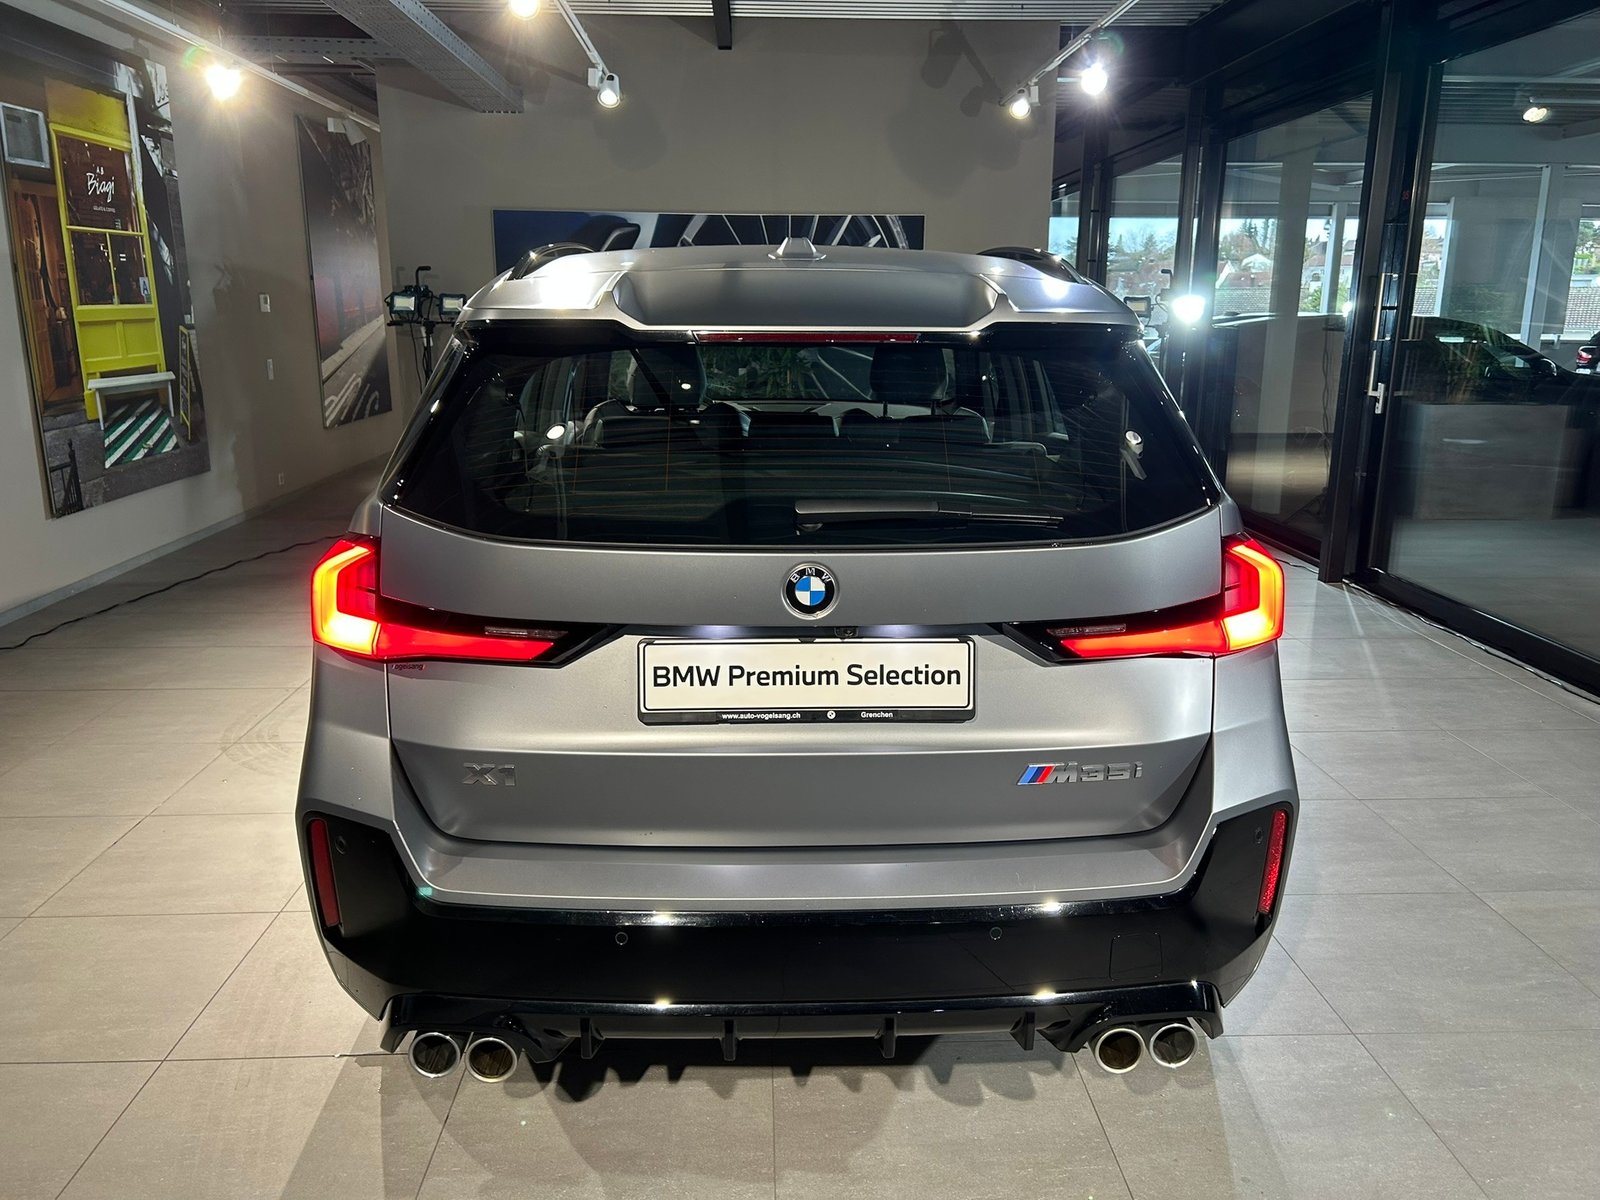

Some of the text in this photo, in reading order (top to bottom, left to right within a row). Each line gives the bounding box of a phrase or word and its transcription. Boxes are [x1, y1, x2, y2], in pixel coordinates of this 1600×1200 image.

[86, 172, 115, 203] Biagi
[790, 567, 832, 583] BMW
[652, 663, 961, 687] BMW Premium Selection
[721, 712, 801, 720] www.auto-vogelsang.ch
[860, 711, 894, 719] Grenchen
[462, 763, 516, 786] X1
[1042, 760, 1144, 784] M35i
